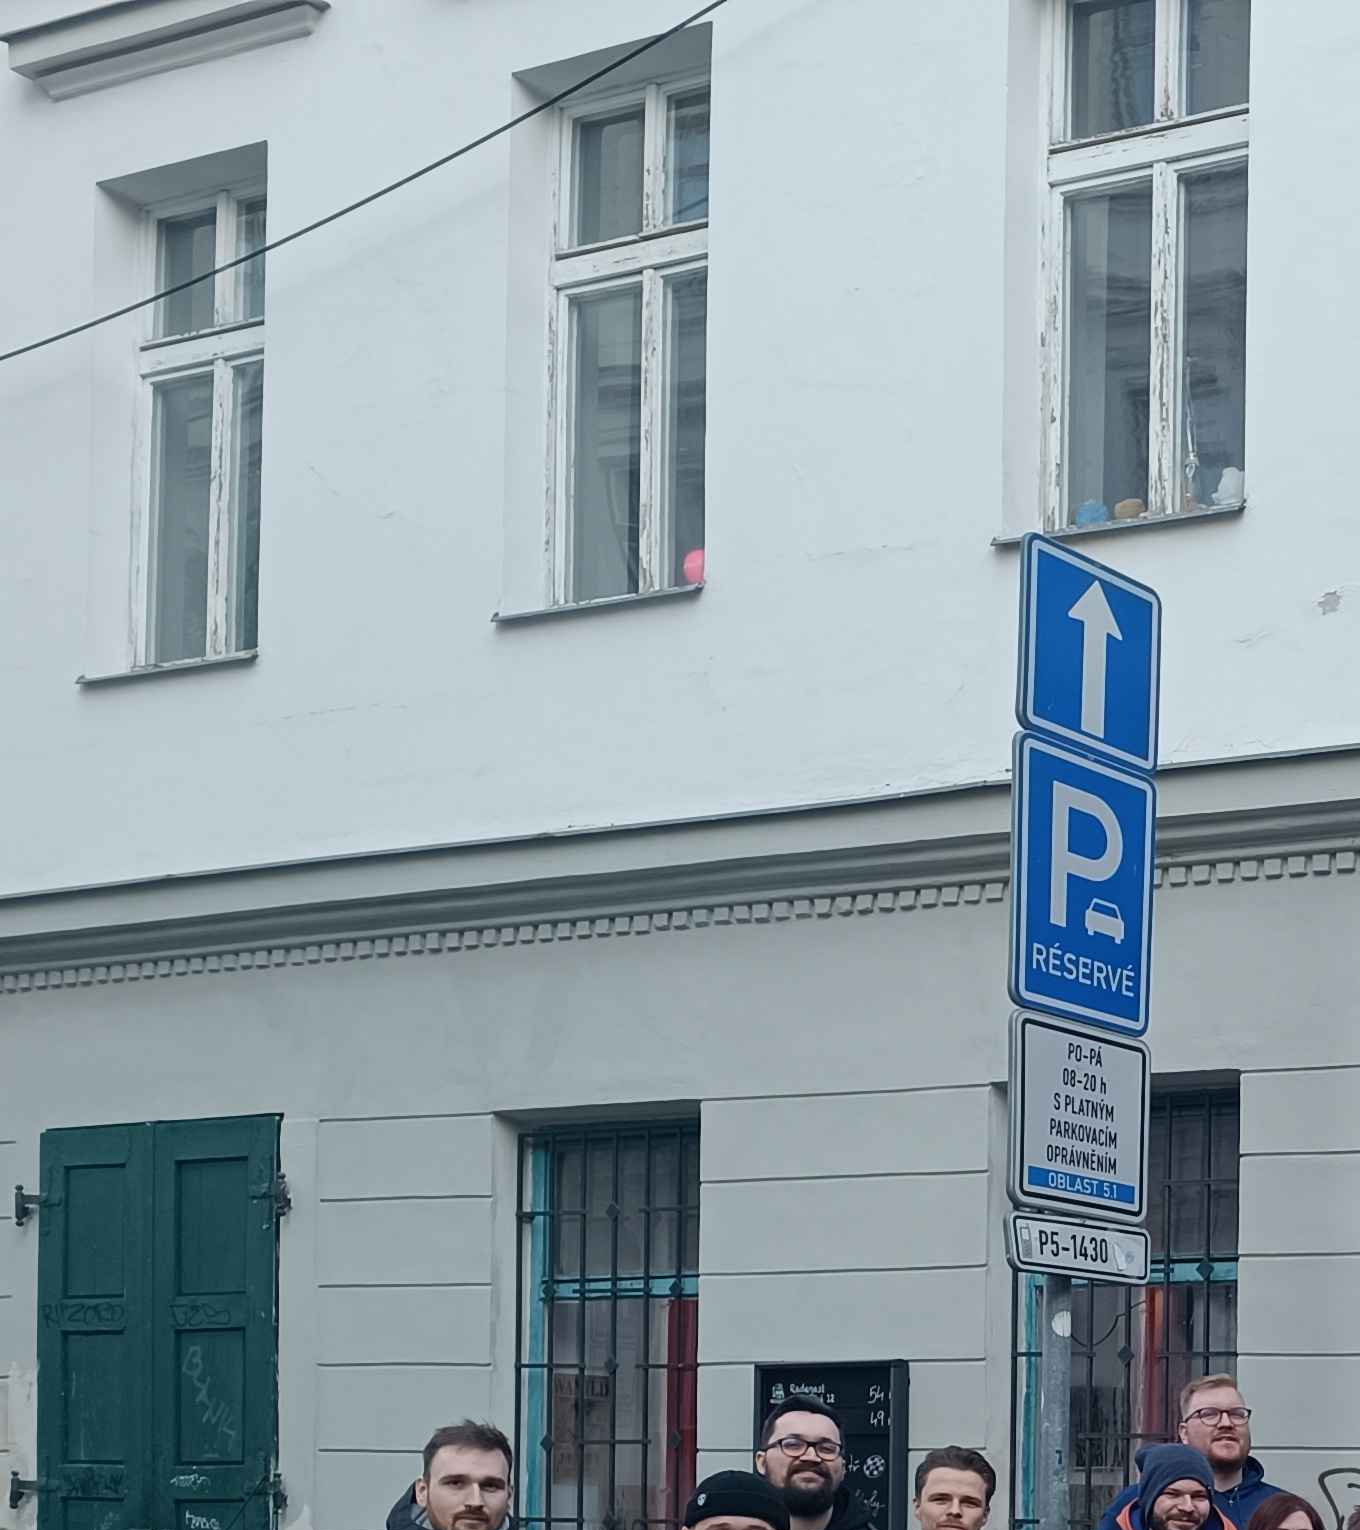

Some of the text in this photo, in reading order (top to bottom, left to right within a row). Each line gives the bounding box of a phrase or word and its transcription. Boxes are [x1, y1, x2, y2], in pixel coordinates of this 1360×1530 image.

[1050, 780, 1123, 928] P
[1033, 942, 1135, 997] RÉSERVÉ
[1067, 1042, 1103, 1068] PO-PÁ
[1062, 1068, 1107, 1095] 08-20 h
[1053, 1093, 1115, 1123] S PLATNÝM
[1049, 1118, 1118, 1150] PARKOVACÍM
[1046, 1143, 1117, 1175] OPRÁVNĚNÍM
[1048, 1172, 1118, 1199] OBLAST 5.1
[1038, 1229, 1109, 1264] P5-1430
